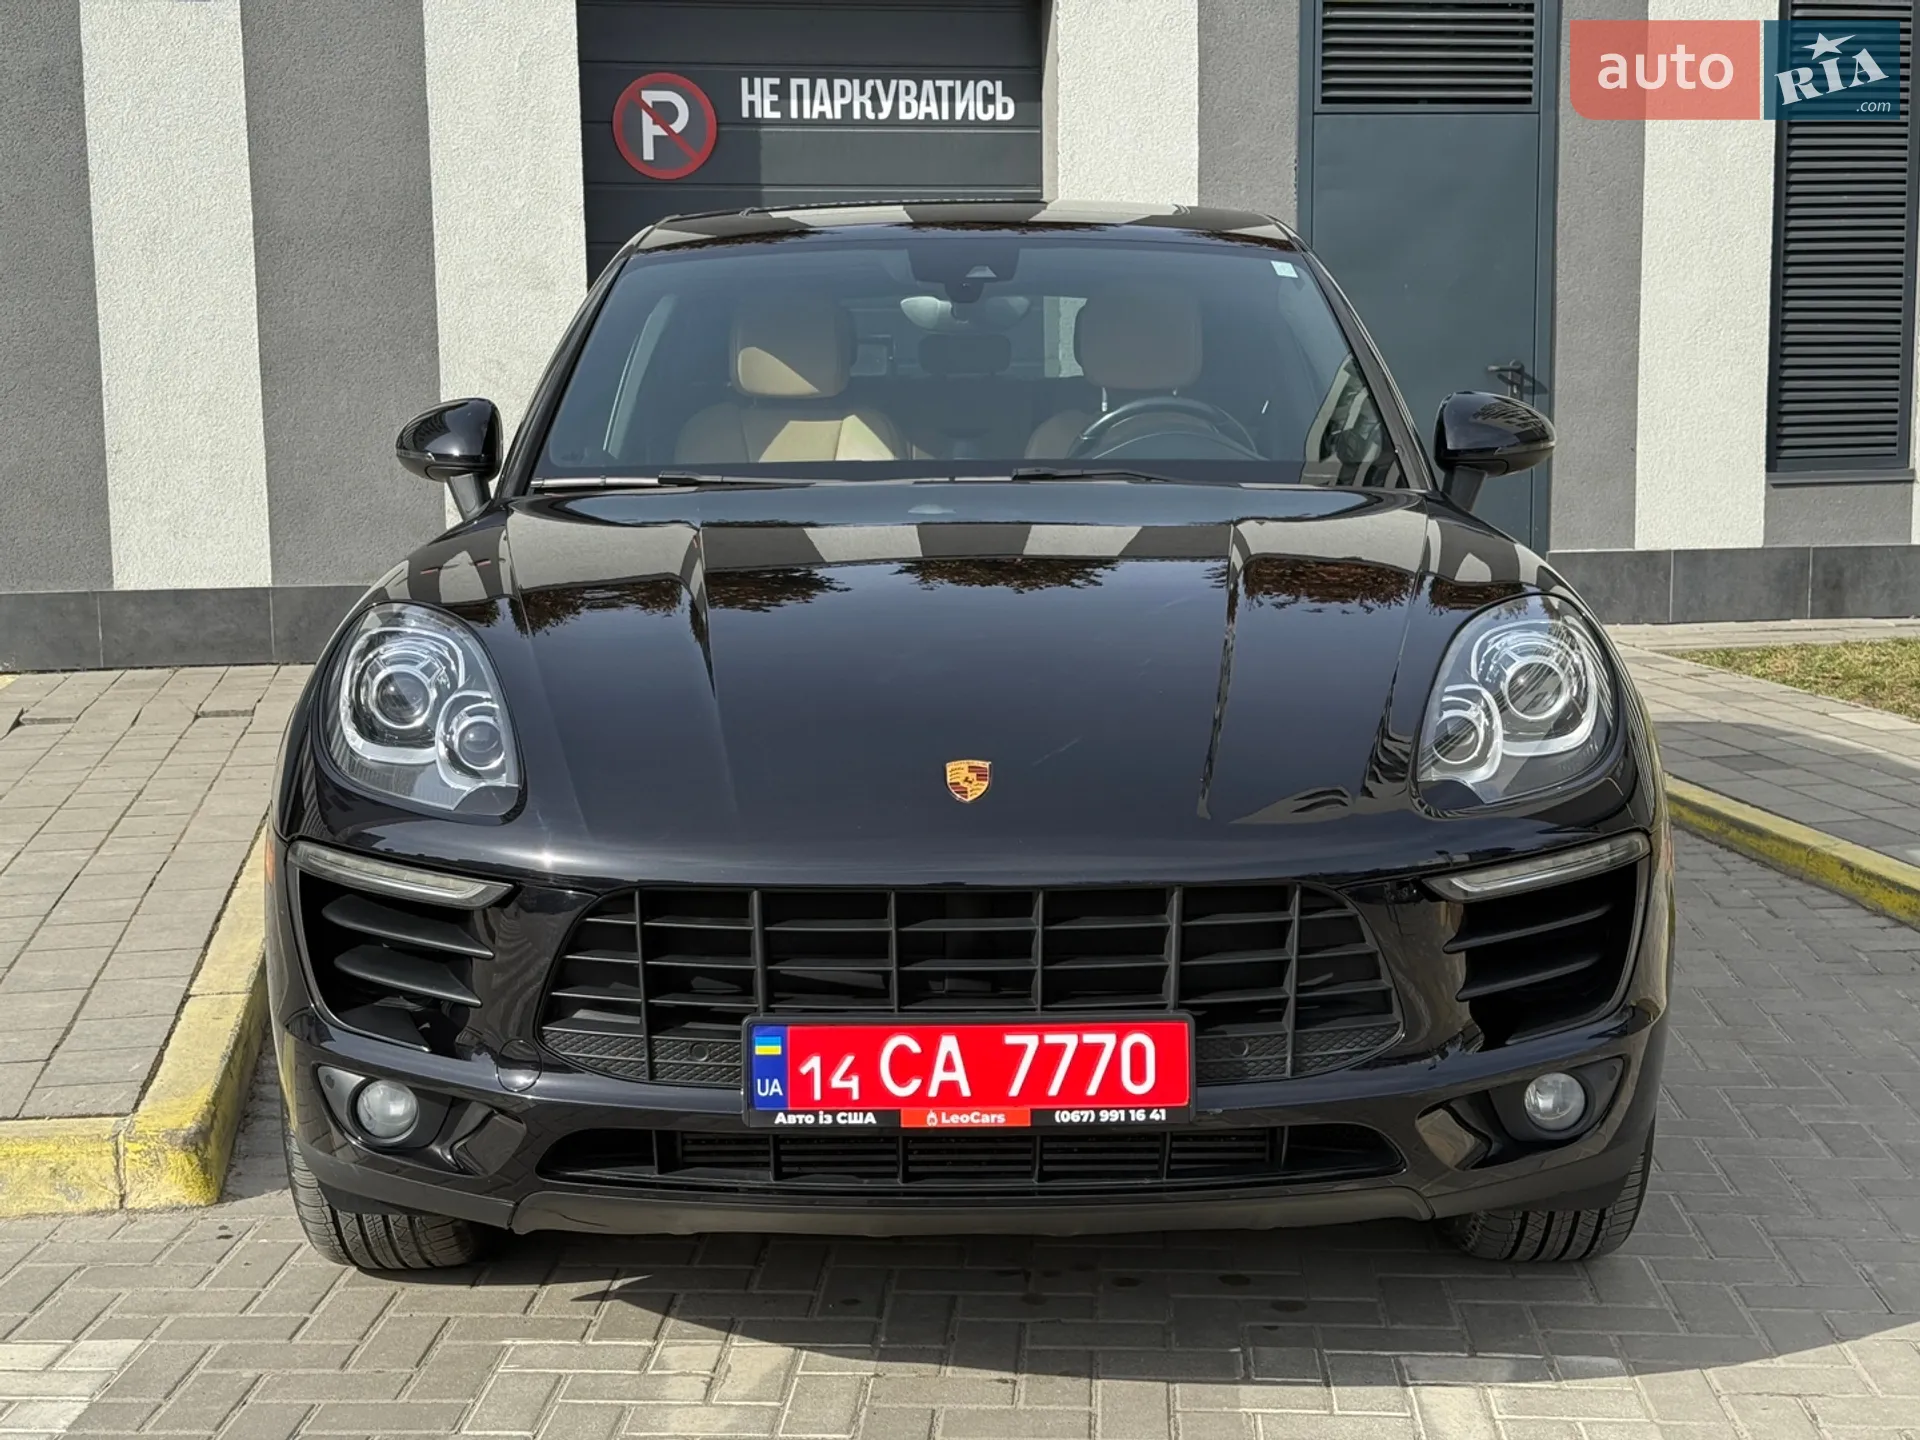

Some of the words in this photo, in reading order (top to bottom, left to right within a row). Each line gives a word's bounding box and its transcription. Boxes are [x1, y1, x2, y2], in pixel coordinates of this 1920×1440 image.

[741, 77, 780, 119] НЕ
[790, 78, 1015, 121] ПАРКУВАТИСЬ
[799, 1054, 860, 1101] 14
[880, 1034, 971, 1098] CA
[1004, 1033, 1156, 1096] 7770
[757, 1078, 783, 1097] UA
[774, 1112, 815, 1124] Авто
[818, 1110, 833, 1124] із
[836, 1112, 877, 1124] США
[941, 1111, 1006, 1124] LeoCars
[1054, 1110, 1095, 1123] (067)
[1099, 1109, 1125, 1122] 991
[1129, 1109, 1146, 1121] 16
[1149, 1108, 1167, 1121] 41
